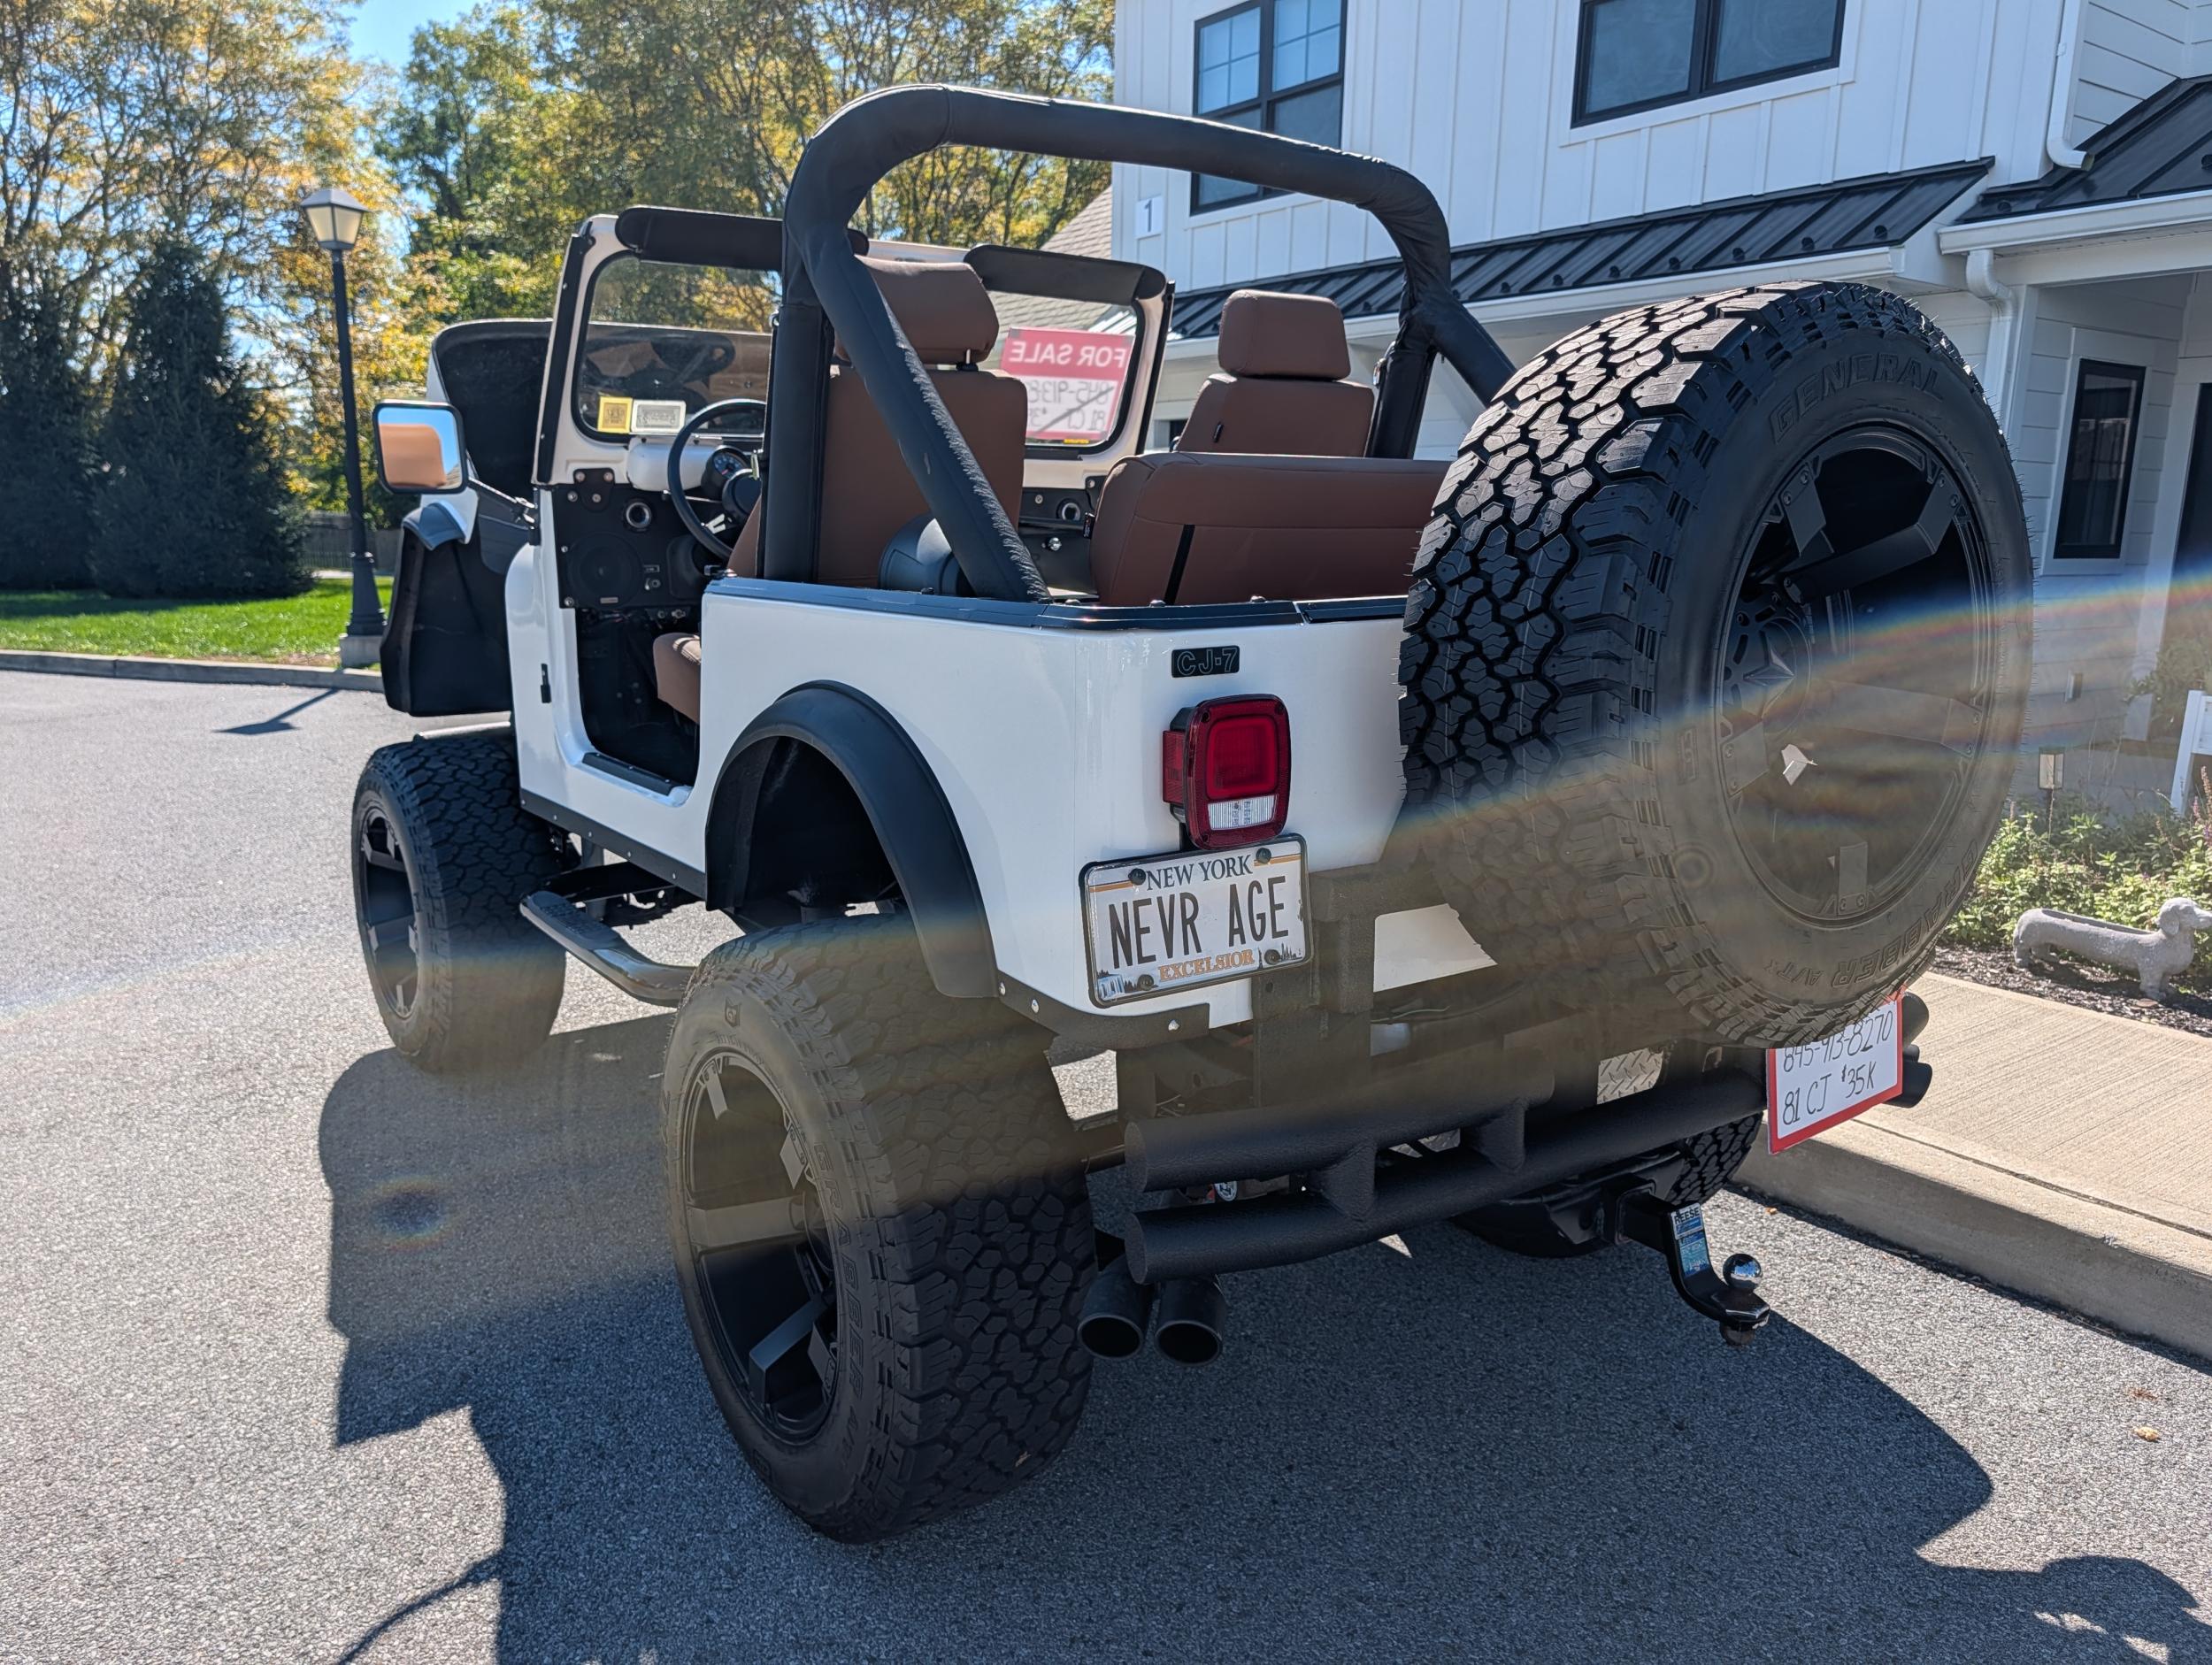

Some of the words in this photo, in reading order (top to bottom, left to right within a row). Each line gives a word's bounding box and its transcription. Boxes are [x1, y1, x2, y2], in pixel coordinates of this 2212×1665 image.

[1144, 199, 1153, 233] 1
[1769, 351, 1944, 445] GENERAL
[1147, 863, 1194, 891] NEW
[1197, 855, 1253, 882] YORK
[1109, 892, 1202, 969] NEVR
[1228, 876, 1288, 948] AGE
[1831, 838, 1978, 988] GRABBER
[1158, 948, 1256, 982] EXCELSIOR
[1782, 1087, 1801, 1125] 81
[1807, 1073, 1832, 1115] CJ
[1673, 1207, 1700, 1225] REESE
